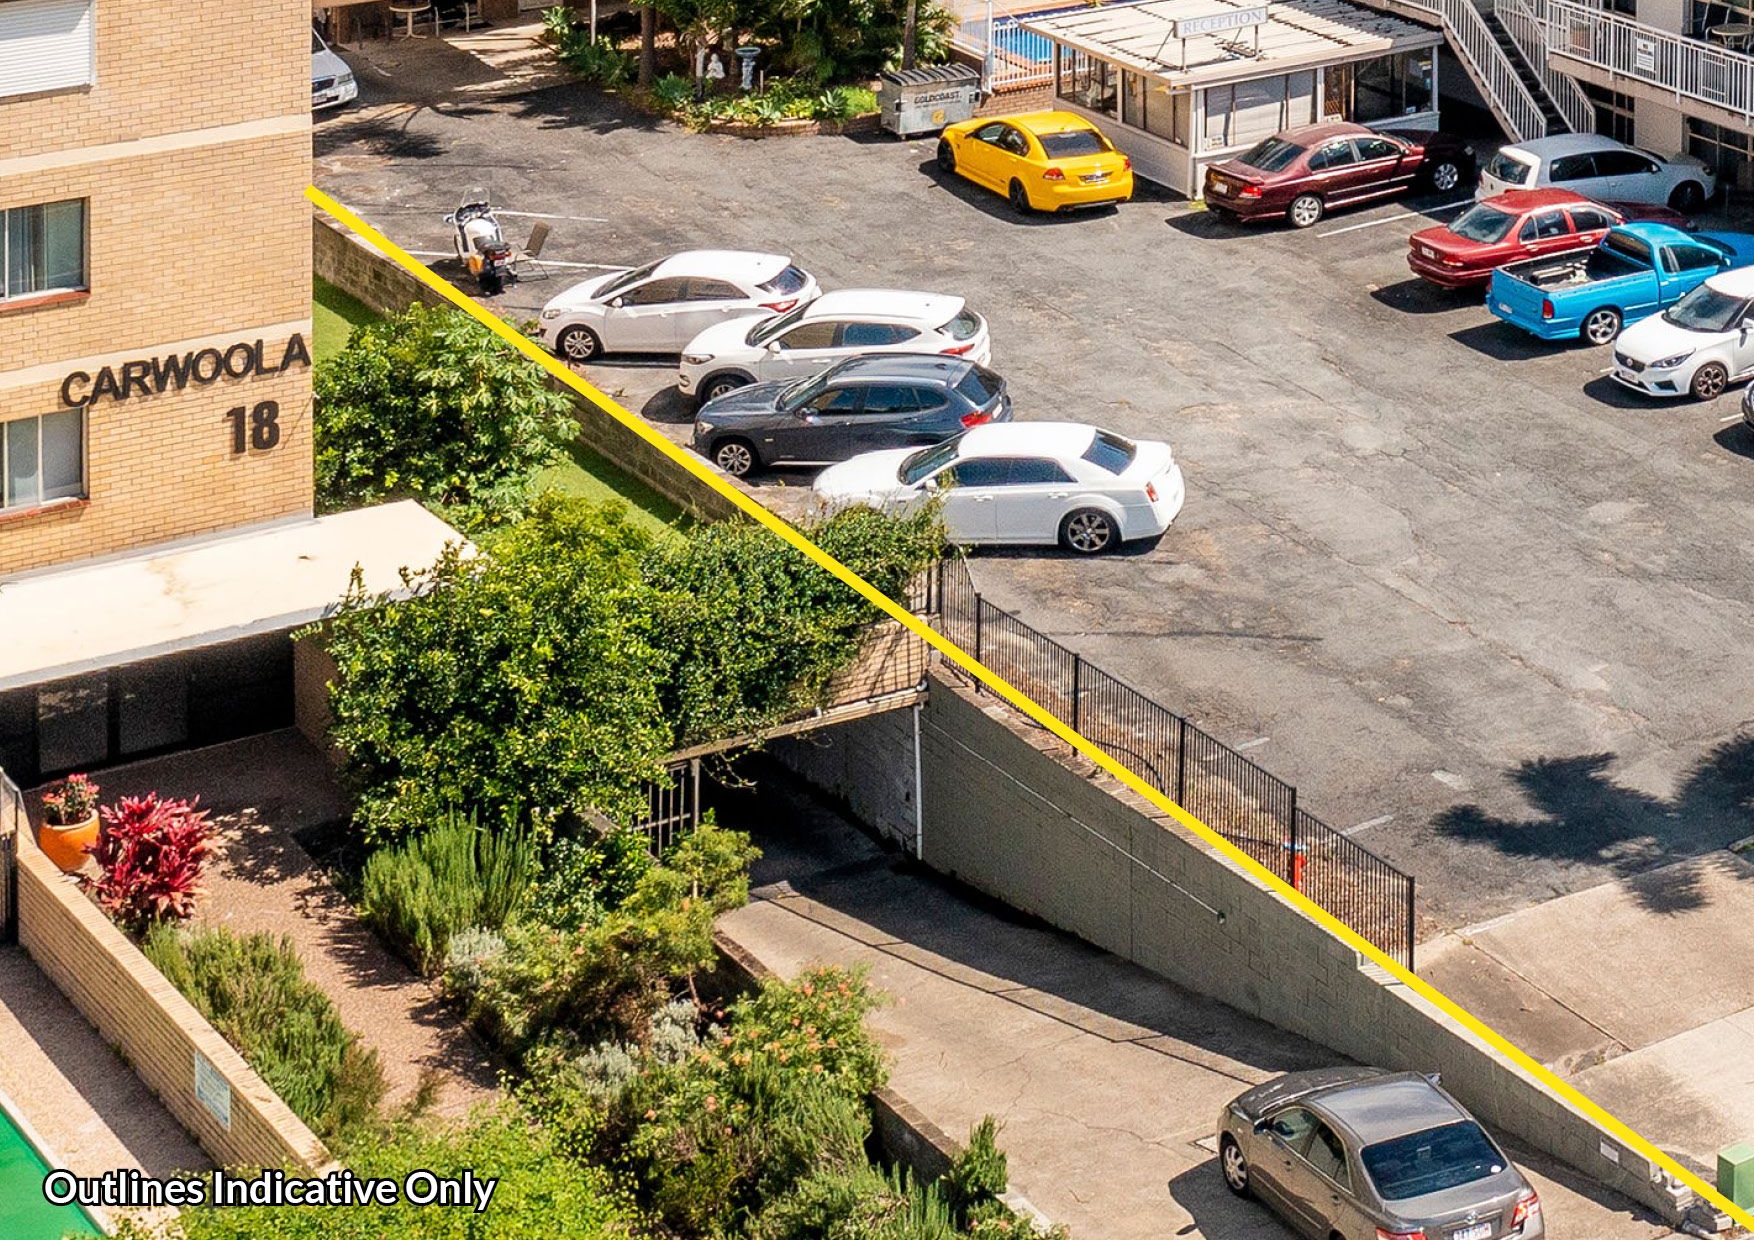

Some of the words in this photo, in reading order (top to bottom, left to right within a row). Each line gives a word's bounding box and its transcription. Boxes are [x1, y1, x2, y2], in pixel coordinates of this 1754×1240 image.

[1184, 11, 1261, 34] RECEPTION
[61, 333, 312, 408] CARWOOLA
[226, 400, 280, 454] 18
